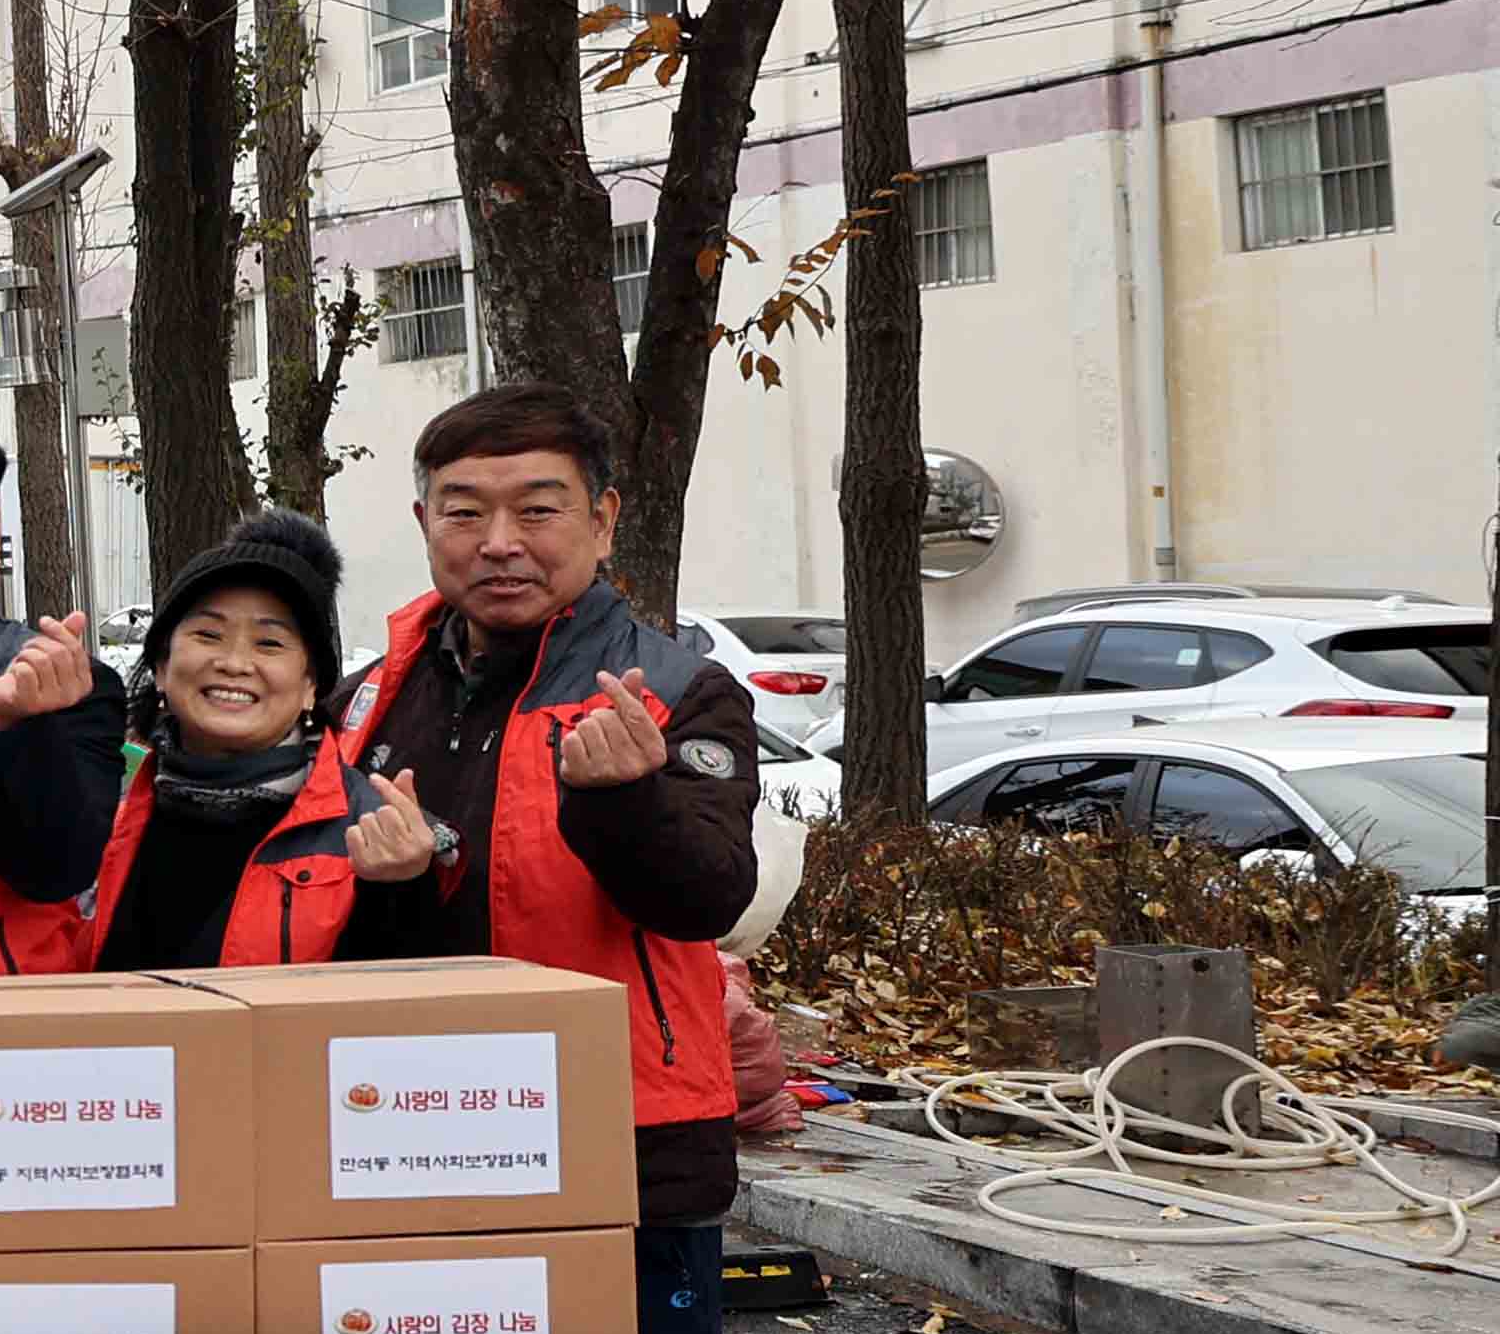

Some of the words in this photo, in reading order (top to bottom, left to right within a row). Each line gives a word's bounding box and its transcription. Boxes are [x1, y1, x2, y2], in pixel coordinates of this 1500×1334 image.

[9, 1099, 68, 1125] 사랑의
[76, 1098, 117, 1123] 김장
[123, 1097, 164, 1121] 나눔
[452, 1312, 488, 1334] 김장
[500, 1310, 536, 1333] 나눔
